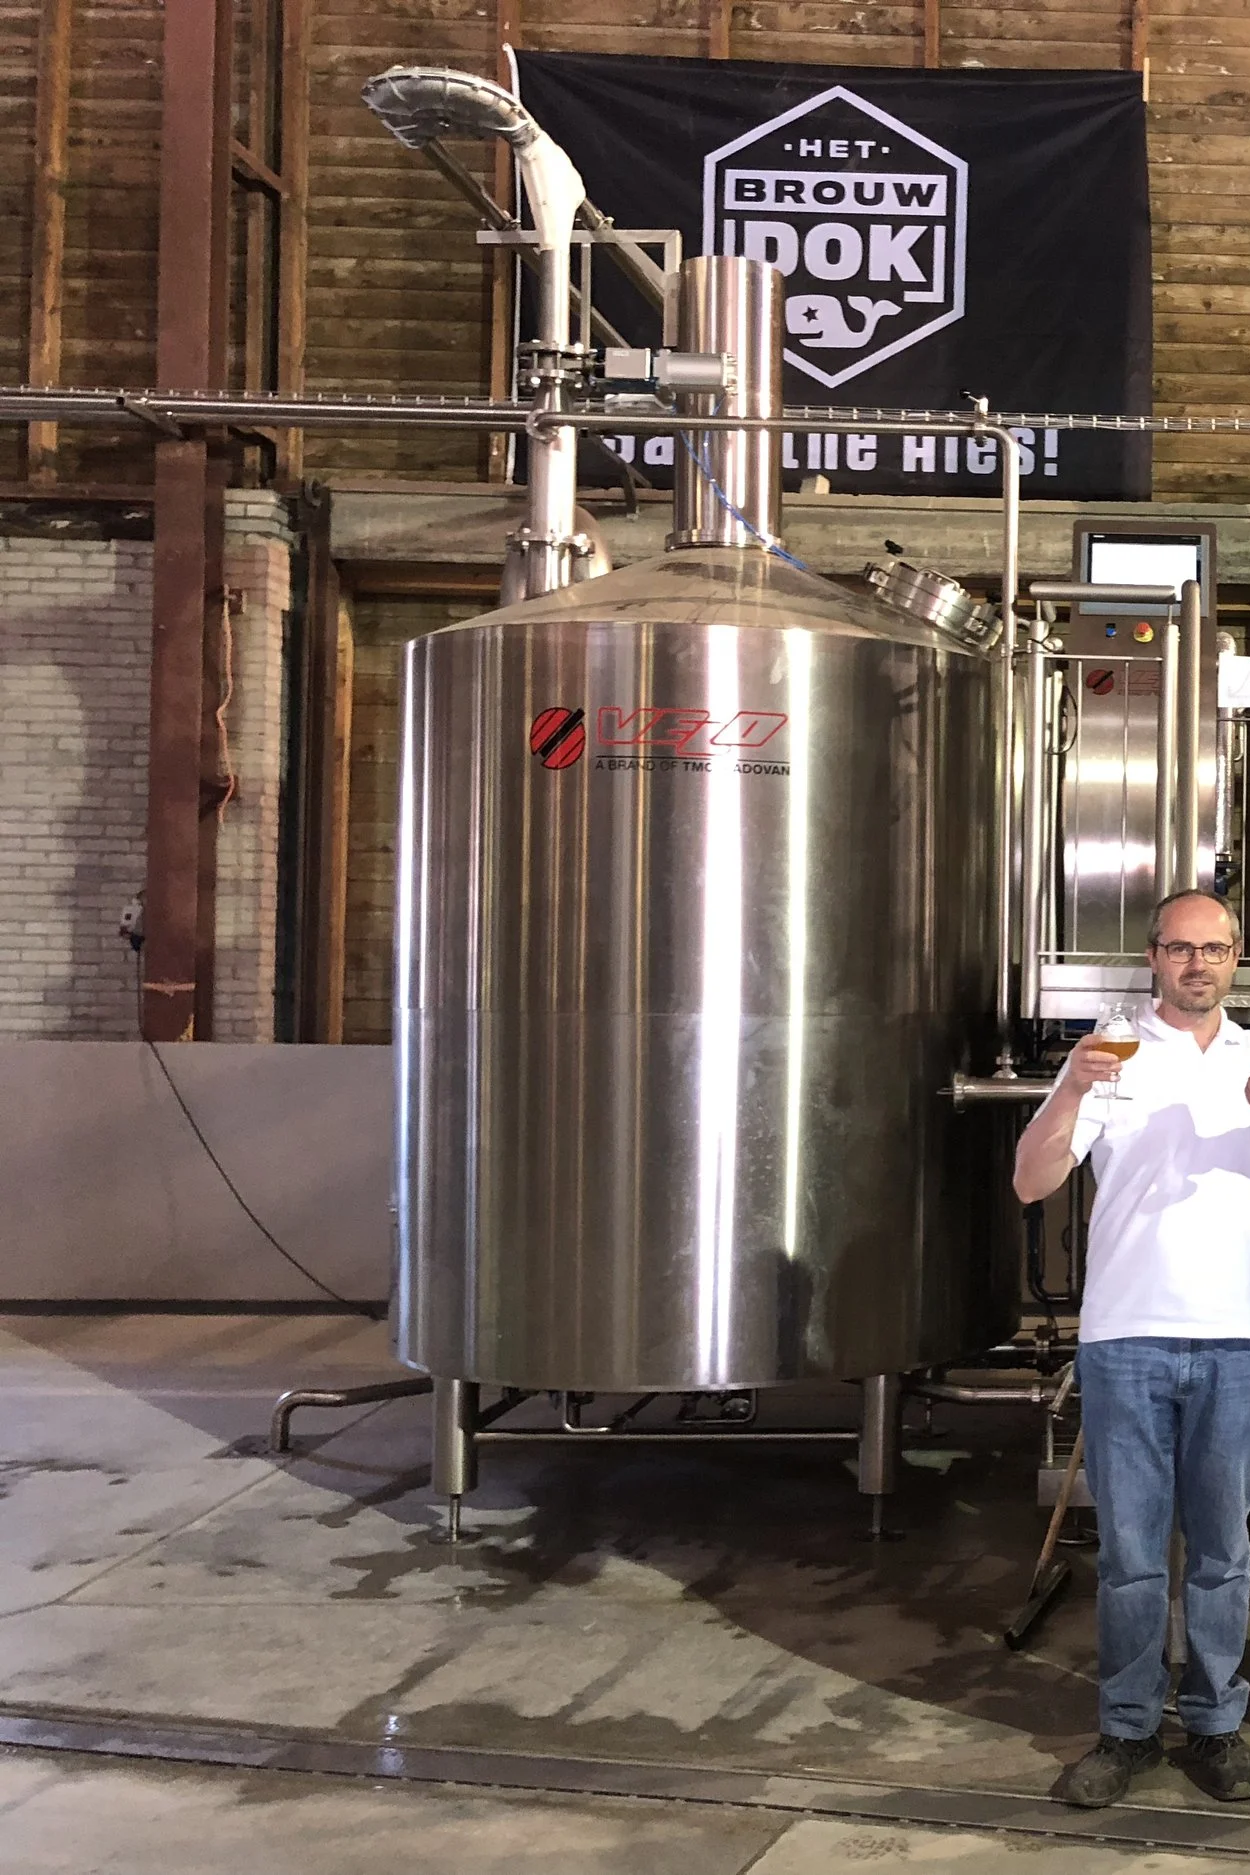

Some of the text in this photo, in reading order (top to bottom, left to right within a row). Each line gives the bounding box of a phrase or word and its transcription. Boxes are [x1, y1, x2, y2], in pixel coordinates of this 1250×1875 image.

[734, 178, 939, 207] BROUW
[744, 220, 929, 283] DOK
[595, 760, 605, 771] A
[659, 761, 677, 773] OF
[683, 762, 714, 774] TMC
[732, 763, 791, 776] ADOVAN
